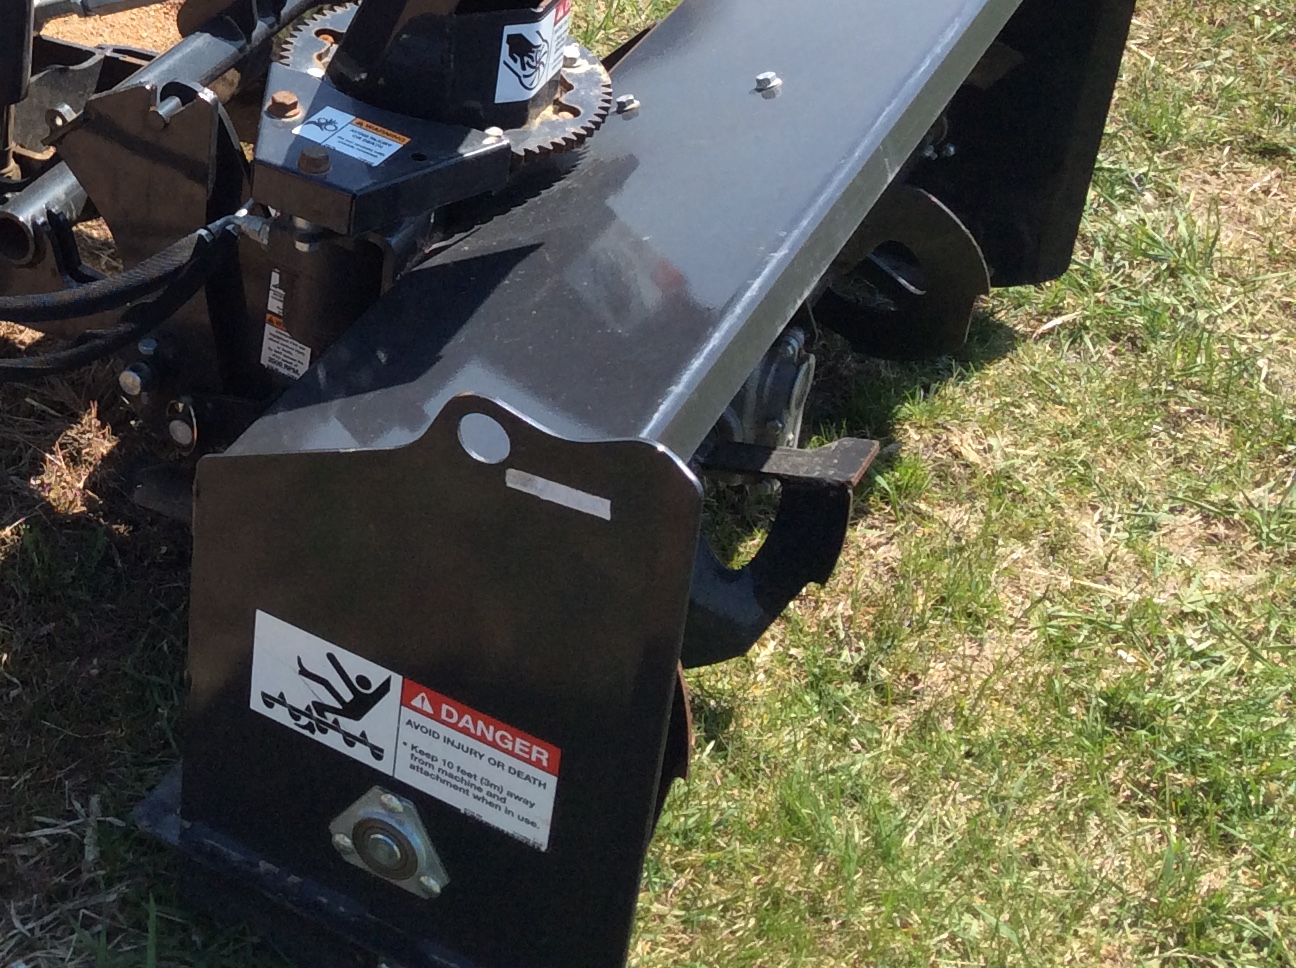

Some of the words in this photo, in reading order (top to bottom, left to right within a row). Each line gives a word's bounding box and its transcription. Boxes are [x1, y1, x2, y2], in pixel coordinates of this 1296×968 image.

[405, 718, 441, 740] AVOID
[442, 735, 485, 761] INJURY
[487, 756, 505, 771] OR
[507, 765, 547, 791] DEATH
[440, 703, 549, 767] DANGER
[408, 763, 470, 797] attachment
[471, 792, 502, 812] when
[504, 806, 515, 818] in
[517, 814, 541, 830] use.
[409, 753, 435, 771] from
[437, 767, 484, 794] machine
[485, 789, 507, 805] and
[410, 743, 439, 763] Keep
[441, 758, 454, 770] 10
[456, 765, 478, 782] feet
[479, 776, 504, 795] (3m)
[506, 790, 536, 809] away
